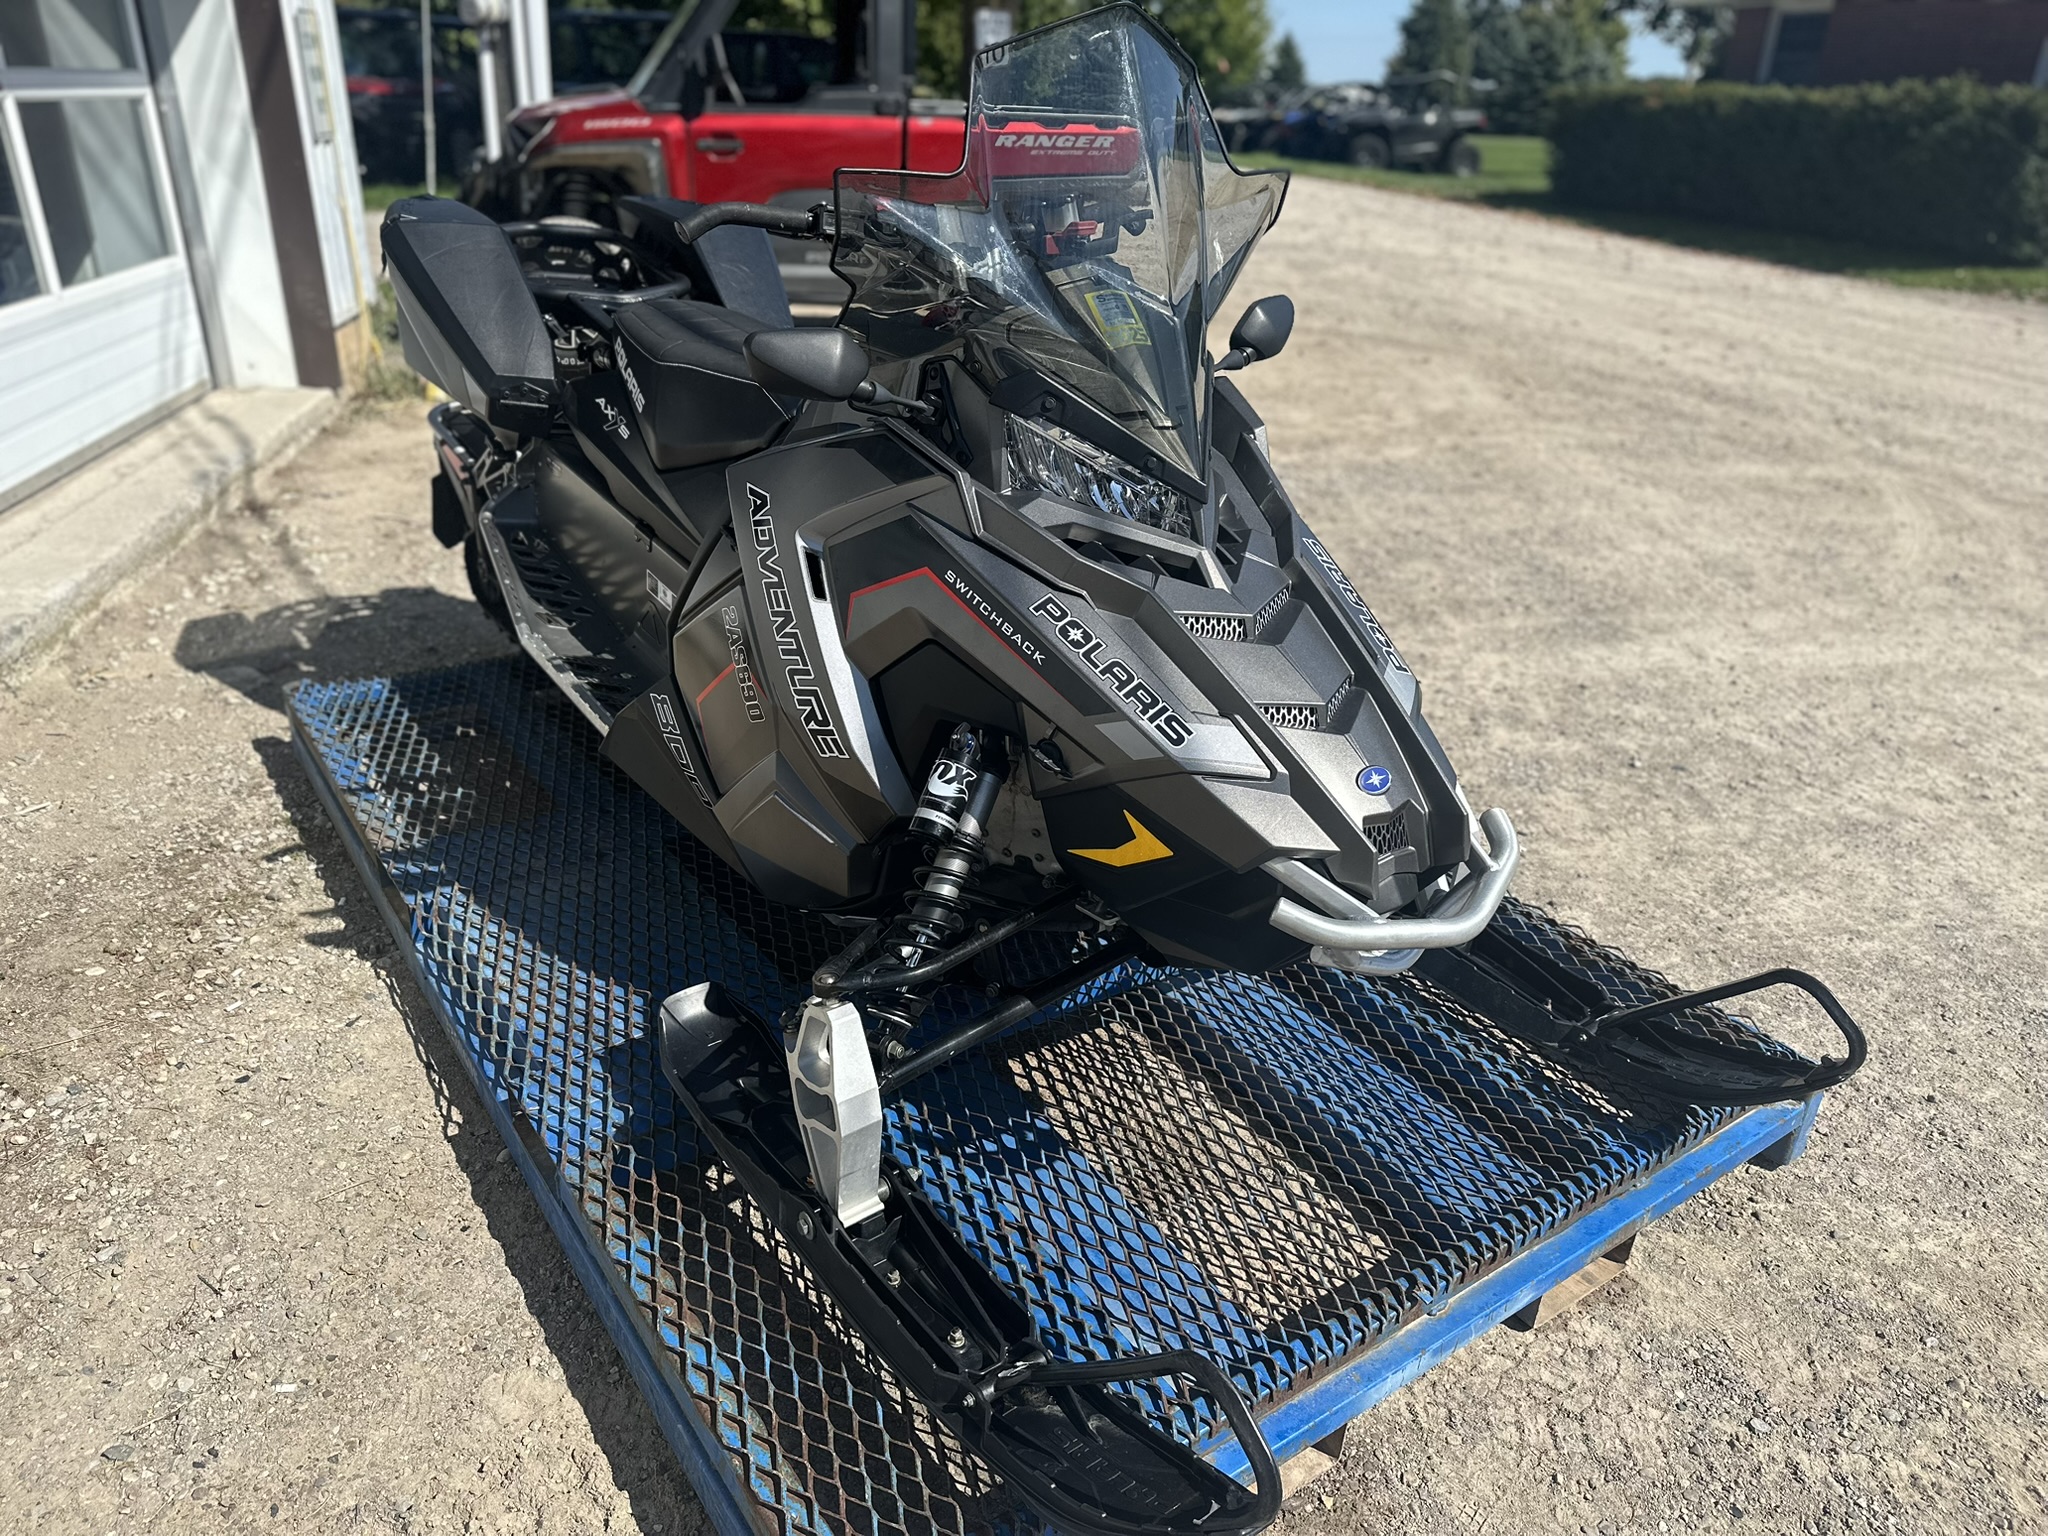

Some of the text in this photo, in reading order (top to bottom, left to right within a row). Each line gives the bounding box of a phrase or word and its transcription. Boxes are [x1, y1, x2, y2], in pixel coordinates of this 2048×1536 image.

[995, 134, 1116, 148] RANGER
[614, 335, 646, 414] POLARIS
[745, 482, 850, 760] ADVENTURE
[944, 569, 1046, 667] SWITCHBACK
[1302, 537, 1412, 675] POLARIS
[1028, 593, 1195, 750] POLARIS
[931, 760, 977, 787] OX
